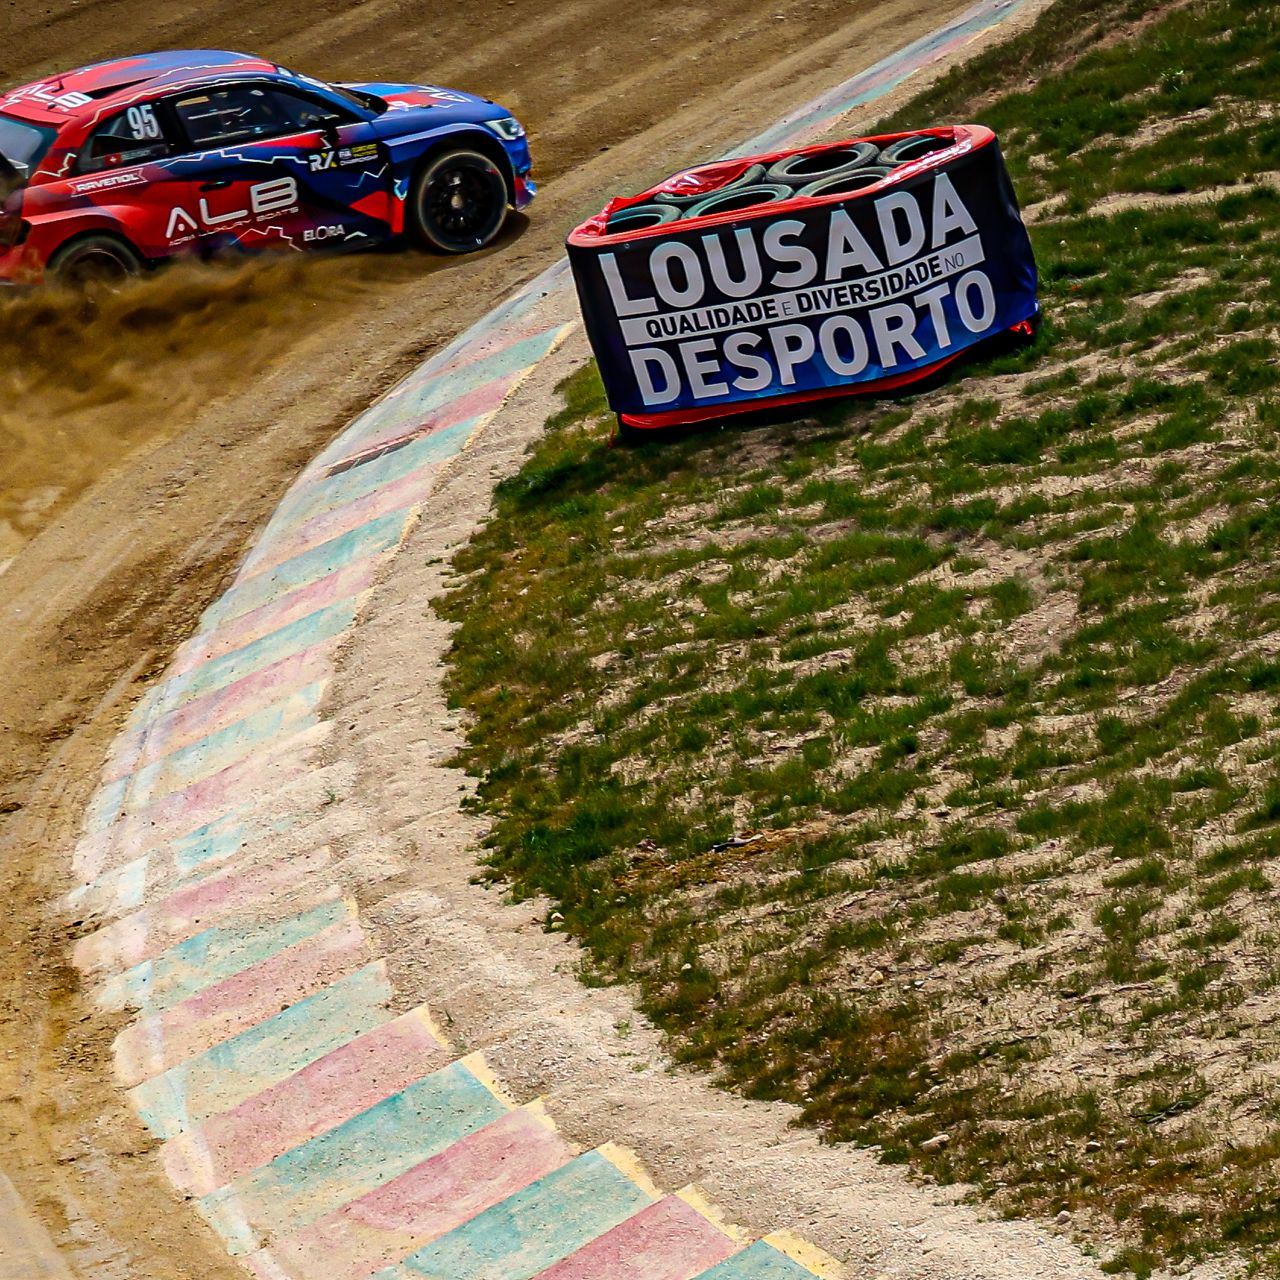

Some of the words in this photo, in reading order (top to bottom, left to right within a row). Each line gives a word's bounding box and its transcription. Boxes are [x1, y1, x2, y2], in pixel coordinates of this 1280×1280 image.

[126, 104, 160, 140] 95
[75, 172, 140, 191] RAVENOL
[309, 151, 337, 172] RX
[165, 176, 298, 239] ALB
[302, 224, 346, 241] ELORA
[598, 171, 979, 317] LOUSADA
[646, 298, 777, 338] QUALIDADE
[782, 299, 795, 317] E
[798, 255, 941, 314] DIVERSIDADE
[944, 251, 965, 272] NO
[628, 269, 997, 406] DESPORTO
